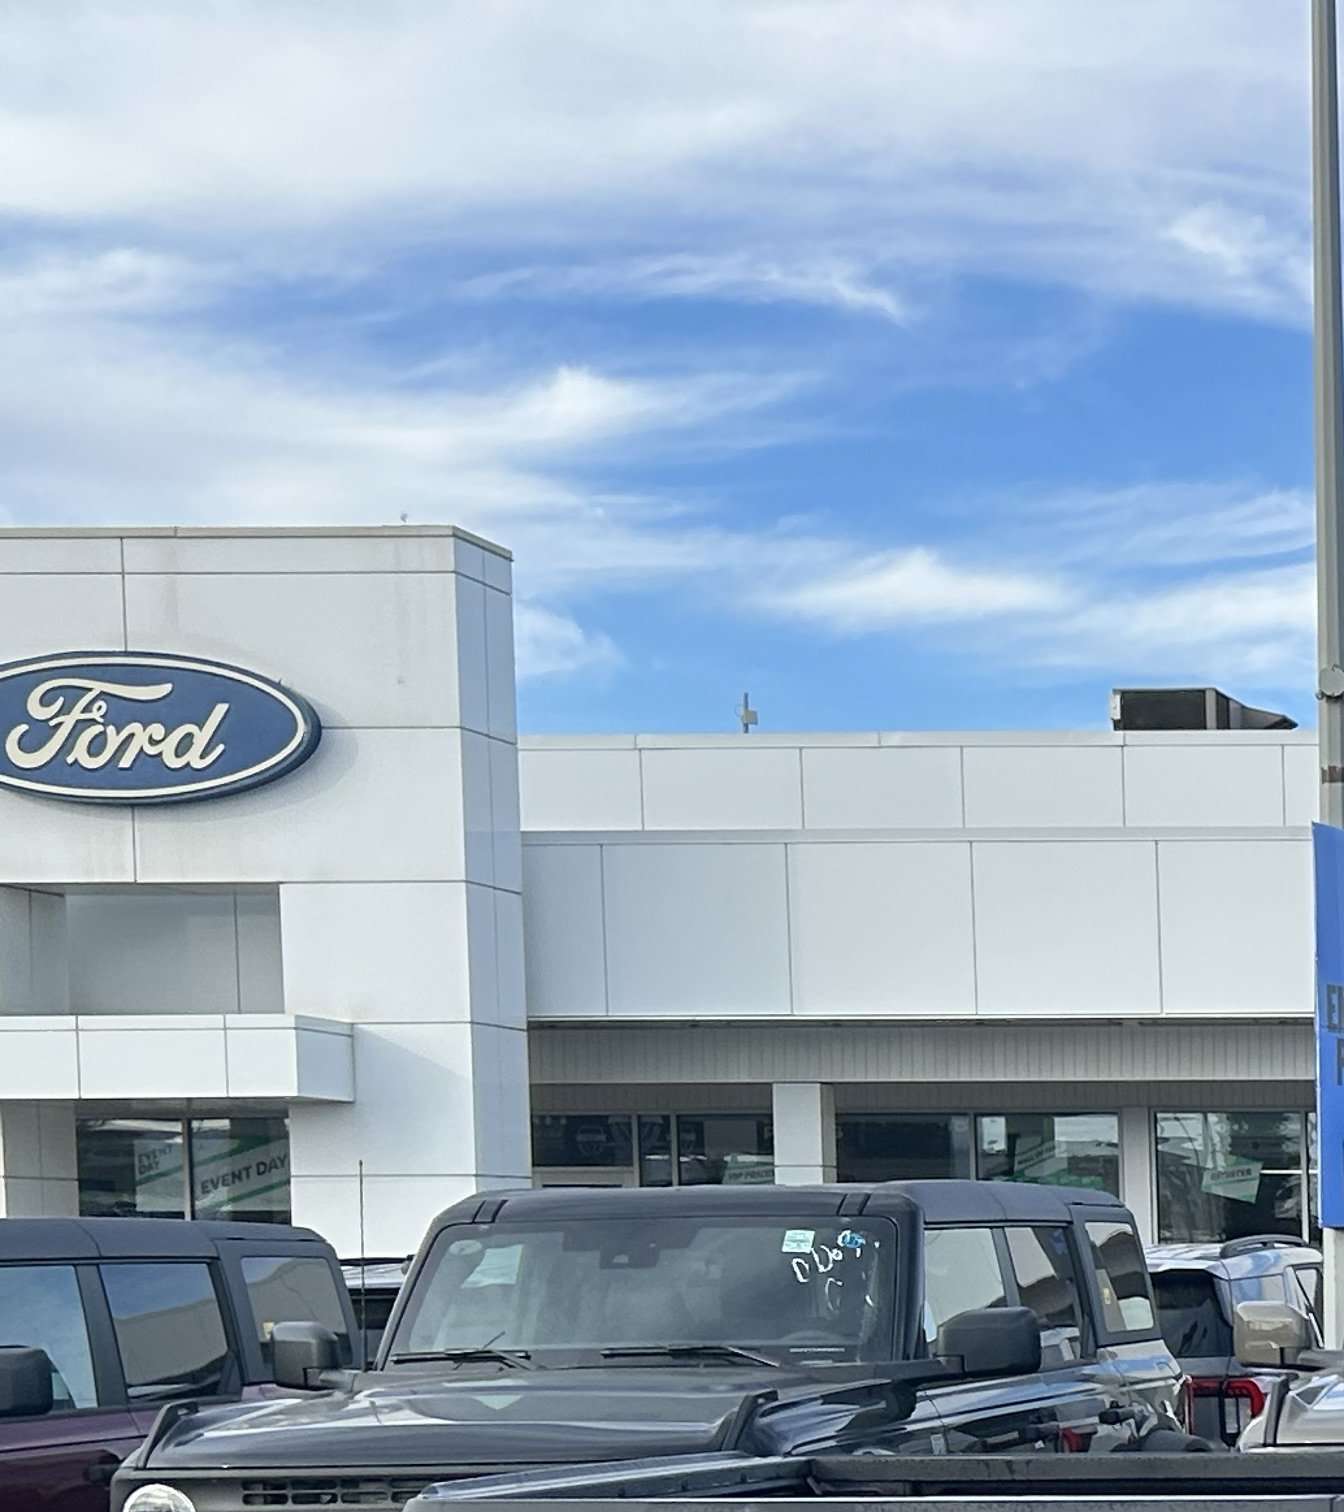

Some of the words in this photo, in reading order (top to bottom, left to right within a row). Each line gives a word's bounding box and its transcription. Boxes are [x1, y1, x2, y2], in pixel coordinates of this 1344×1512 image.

[6, 678, 229, 769] Ford
[201, 1166, 253, 1195] EVENT
[255, 1154, 288, 1176] DAY
